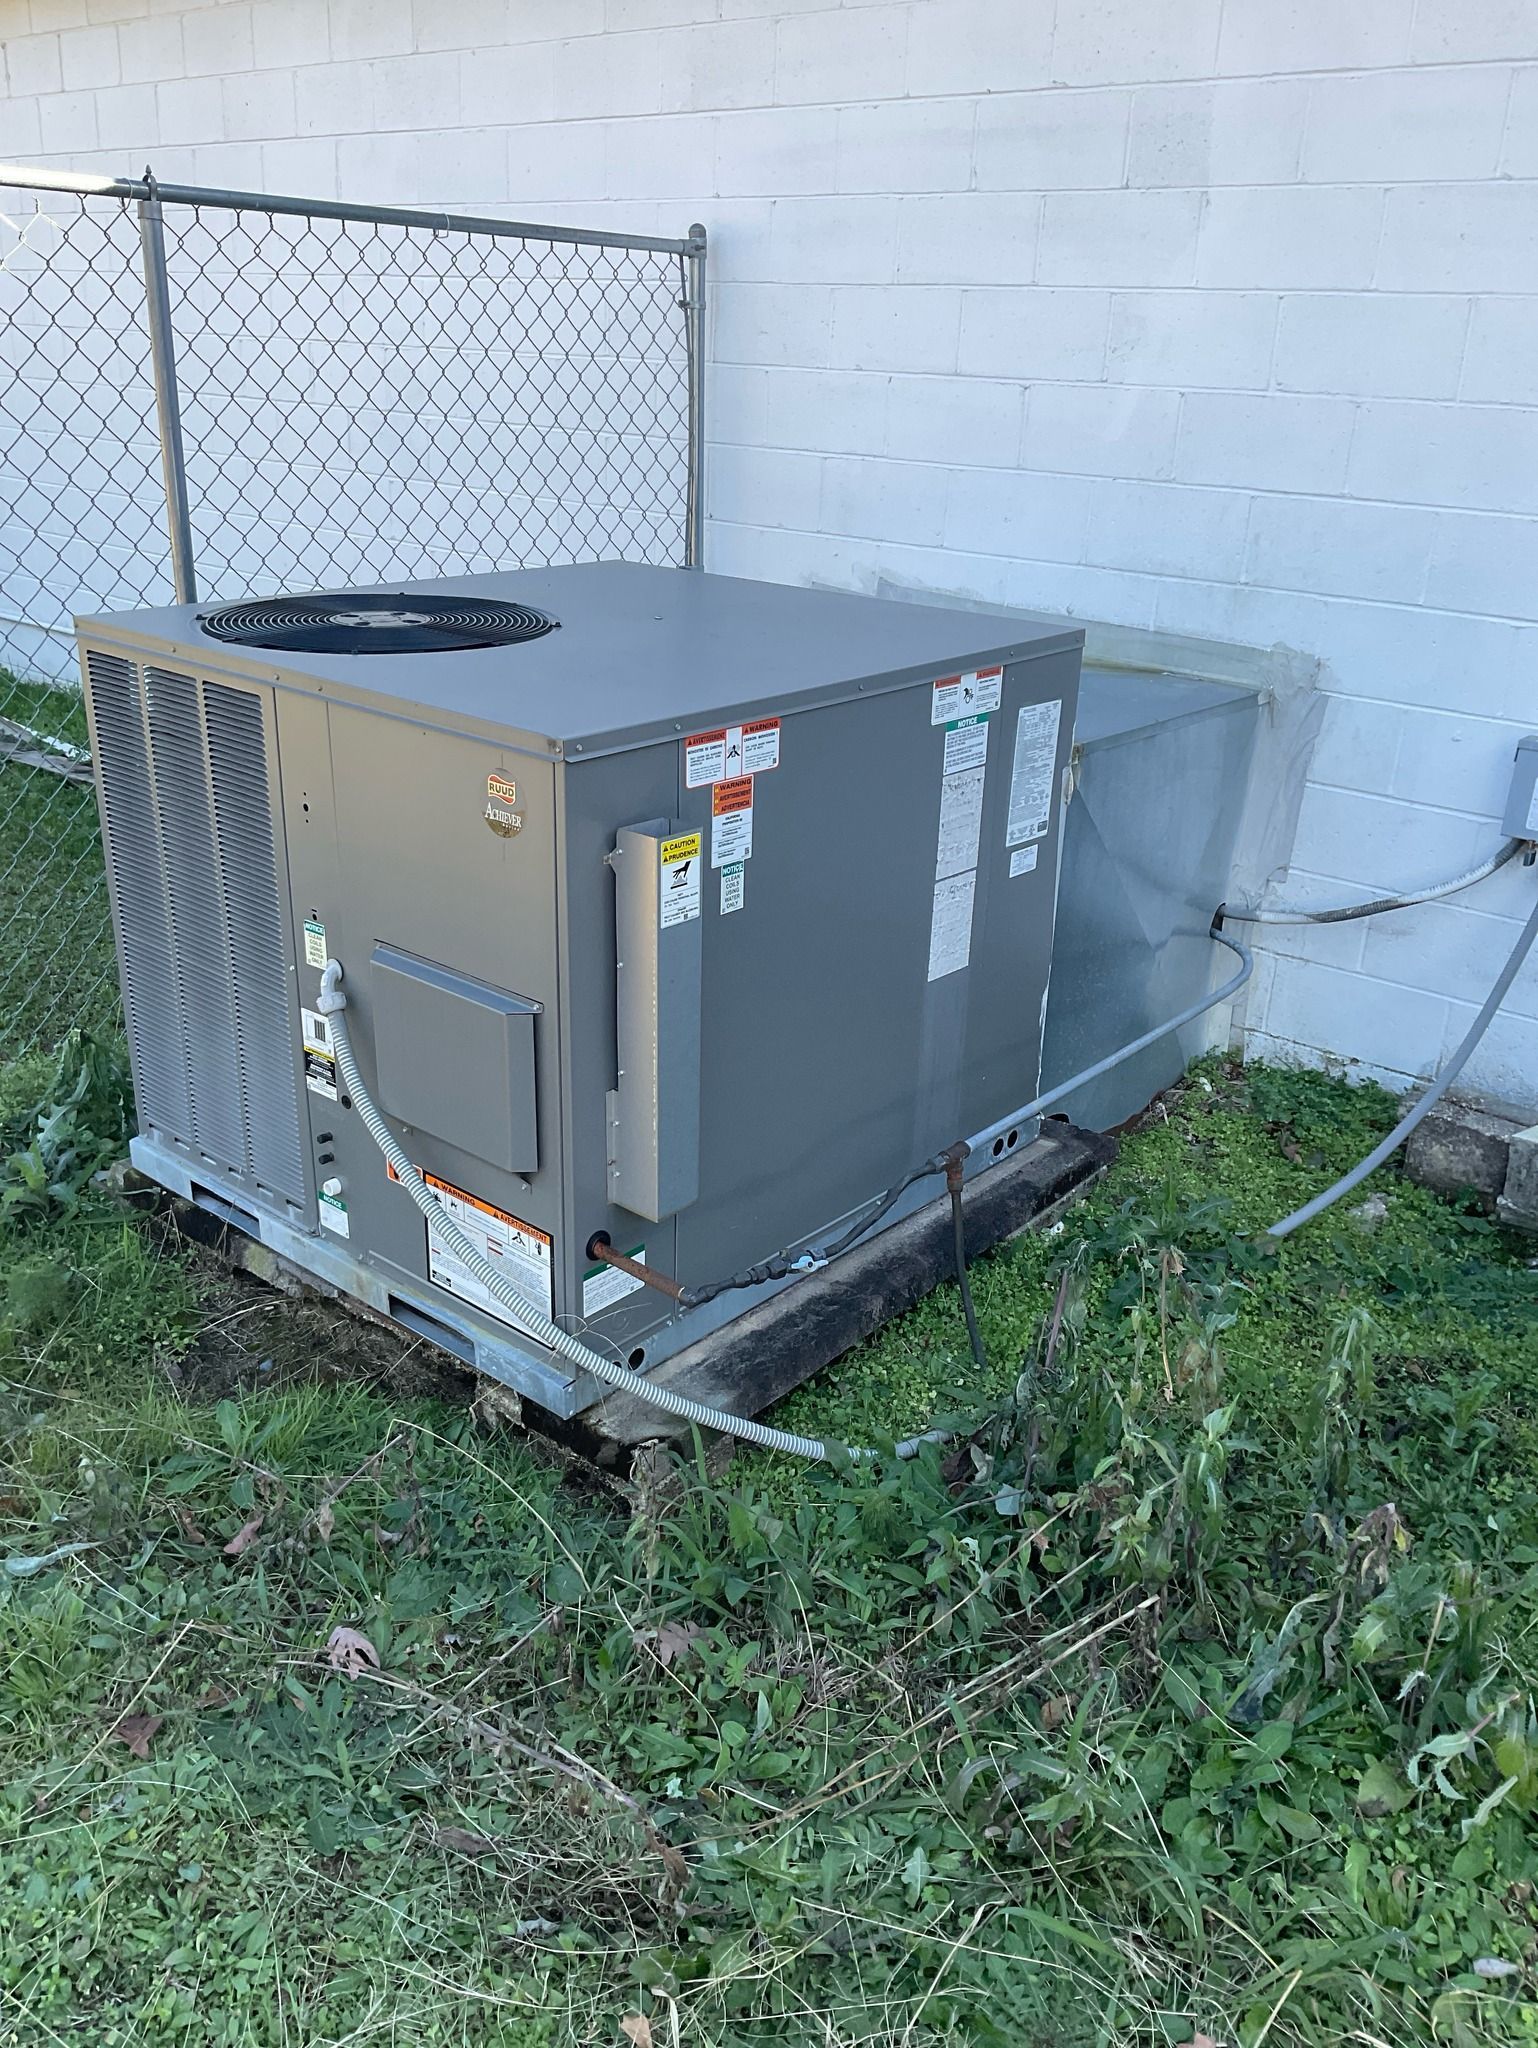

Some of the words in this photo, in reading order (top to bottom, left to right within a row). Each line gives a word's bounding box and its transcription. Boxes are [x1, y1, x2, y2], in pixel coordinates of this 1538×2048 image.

[749, 720, 779, 732] WARNING
[958, 716, 978, 728] NOTICE
[489, 783, 514, 796] RUUD
[720, 778, 752, 791] WARNING
[719, 788, 752, 802] AVERTISSEMENT
[721, 799, 750, 812] ADVERTENCIA
[669, 838, 696, 851] CAUTION
[668, 847, 699, 861] PRUDENCE
[722, 863, 744, 875] NOTICE
[725, 874, 741, 883] CLEAN
[725, 880, 740, 890] COILS
[725, 887, 740, 896] USING
[724, 893, 741, 903] WATER
[726, 899, 739, 909] ONLY
[305, 923, 324, 934] NOTICE
[441, 1183, 476, 1206] WARNING
[323, 1194, 342, 1209] NOTICE
[500, 1213, 547, 1242] AVERTISSEMENT
